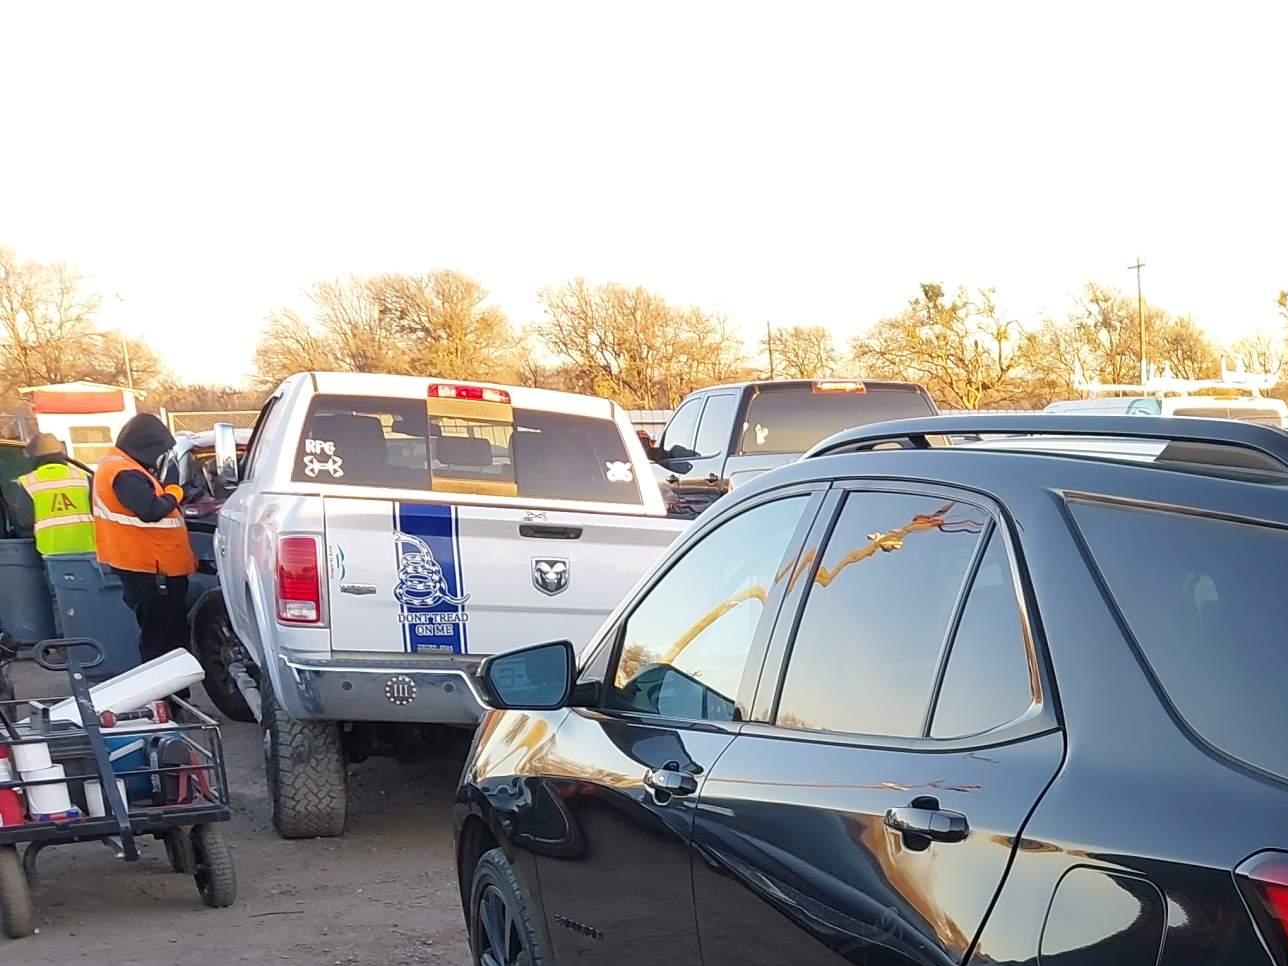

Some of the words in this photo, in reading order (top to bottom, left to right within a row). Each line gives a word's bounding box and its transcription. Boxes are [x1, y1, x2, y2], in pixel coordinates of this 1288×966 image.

[305, 439, 335, 455] RPG
[432, 613, 469, 622] TREAD
[416, 625, 432, 635] ON
[435, 625, 453, 635] ME
